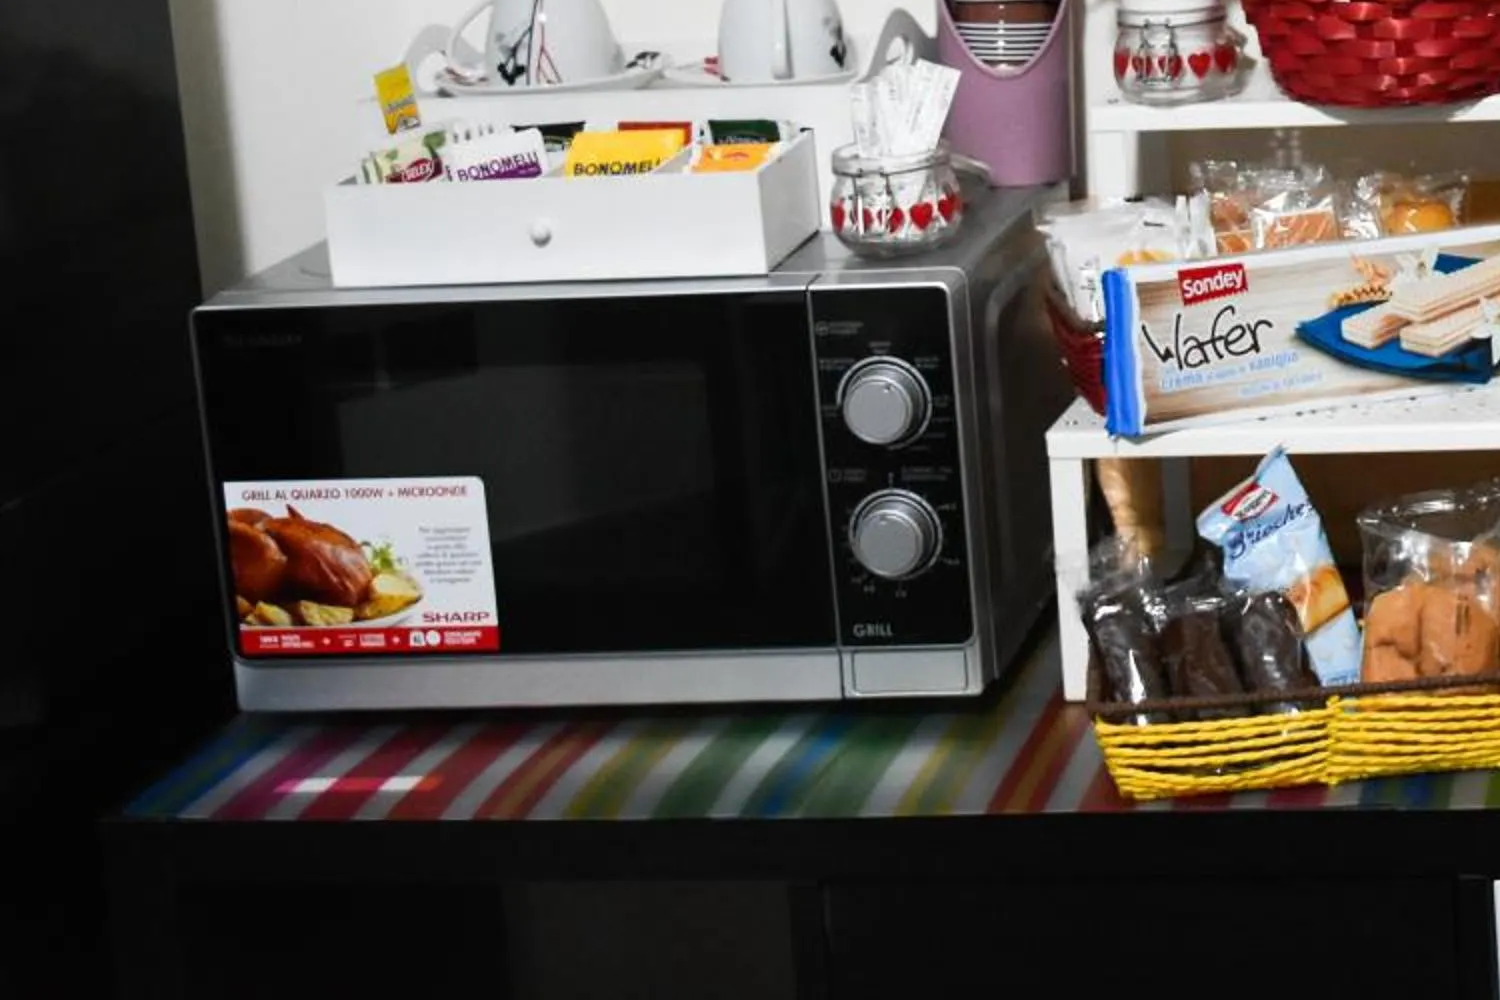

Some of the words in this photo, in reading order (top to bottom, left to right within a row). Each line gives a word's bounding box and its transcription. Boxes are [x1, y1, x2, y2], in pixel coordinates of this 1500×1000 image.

[457, 152, 539, 181] BONOMELLI
[1182, 269, 1243, 299] Sondey
[1141, 305, 1274, 371] Wafer
[242, 489, 272, 501] GRILL
[275, 489, 287, 500] AL
[290, 488, 342, 500] QUARZO
[344, 487, 384, 499] 1000W
[397, 485, 468, 498] MICROONDE
[422, 611, 491, 623] SHARP
[852, 622, 895, 638] GRILL
